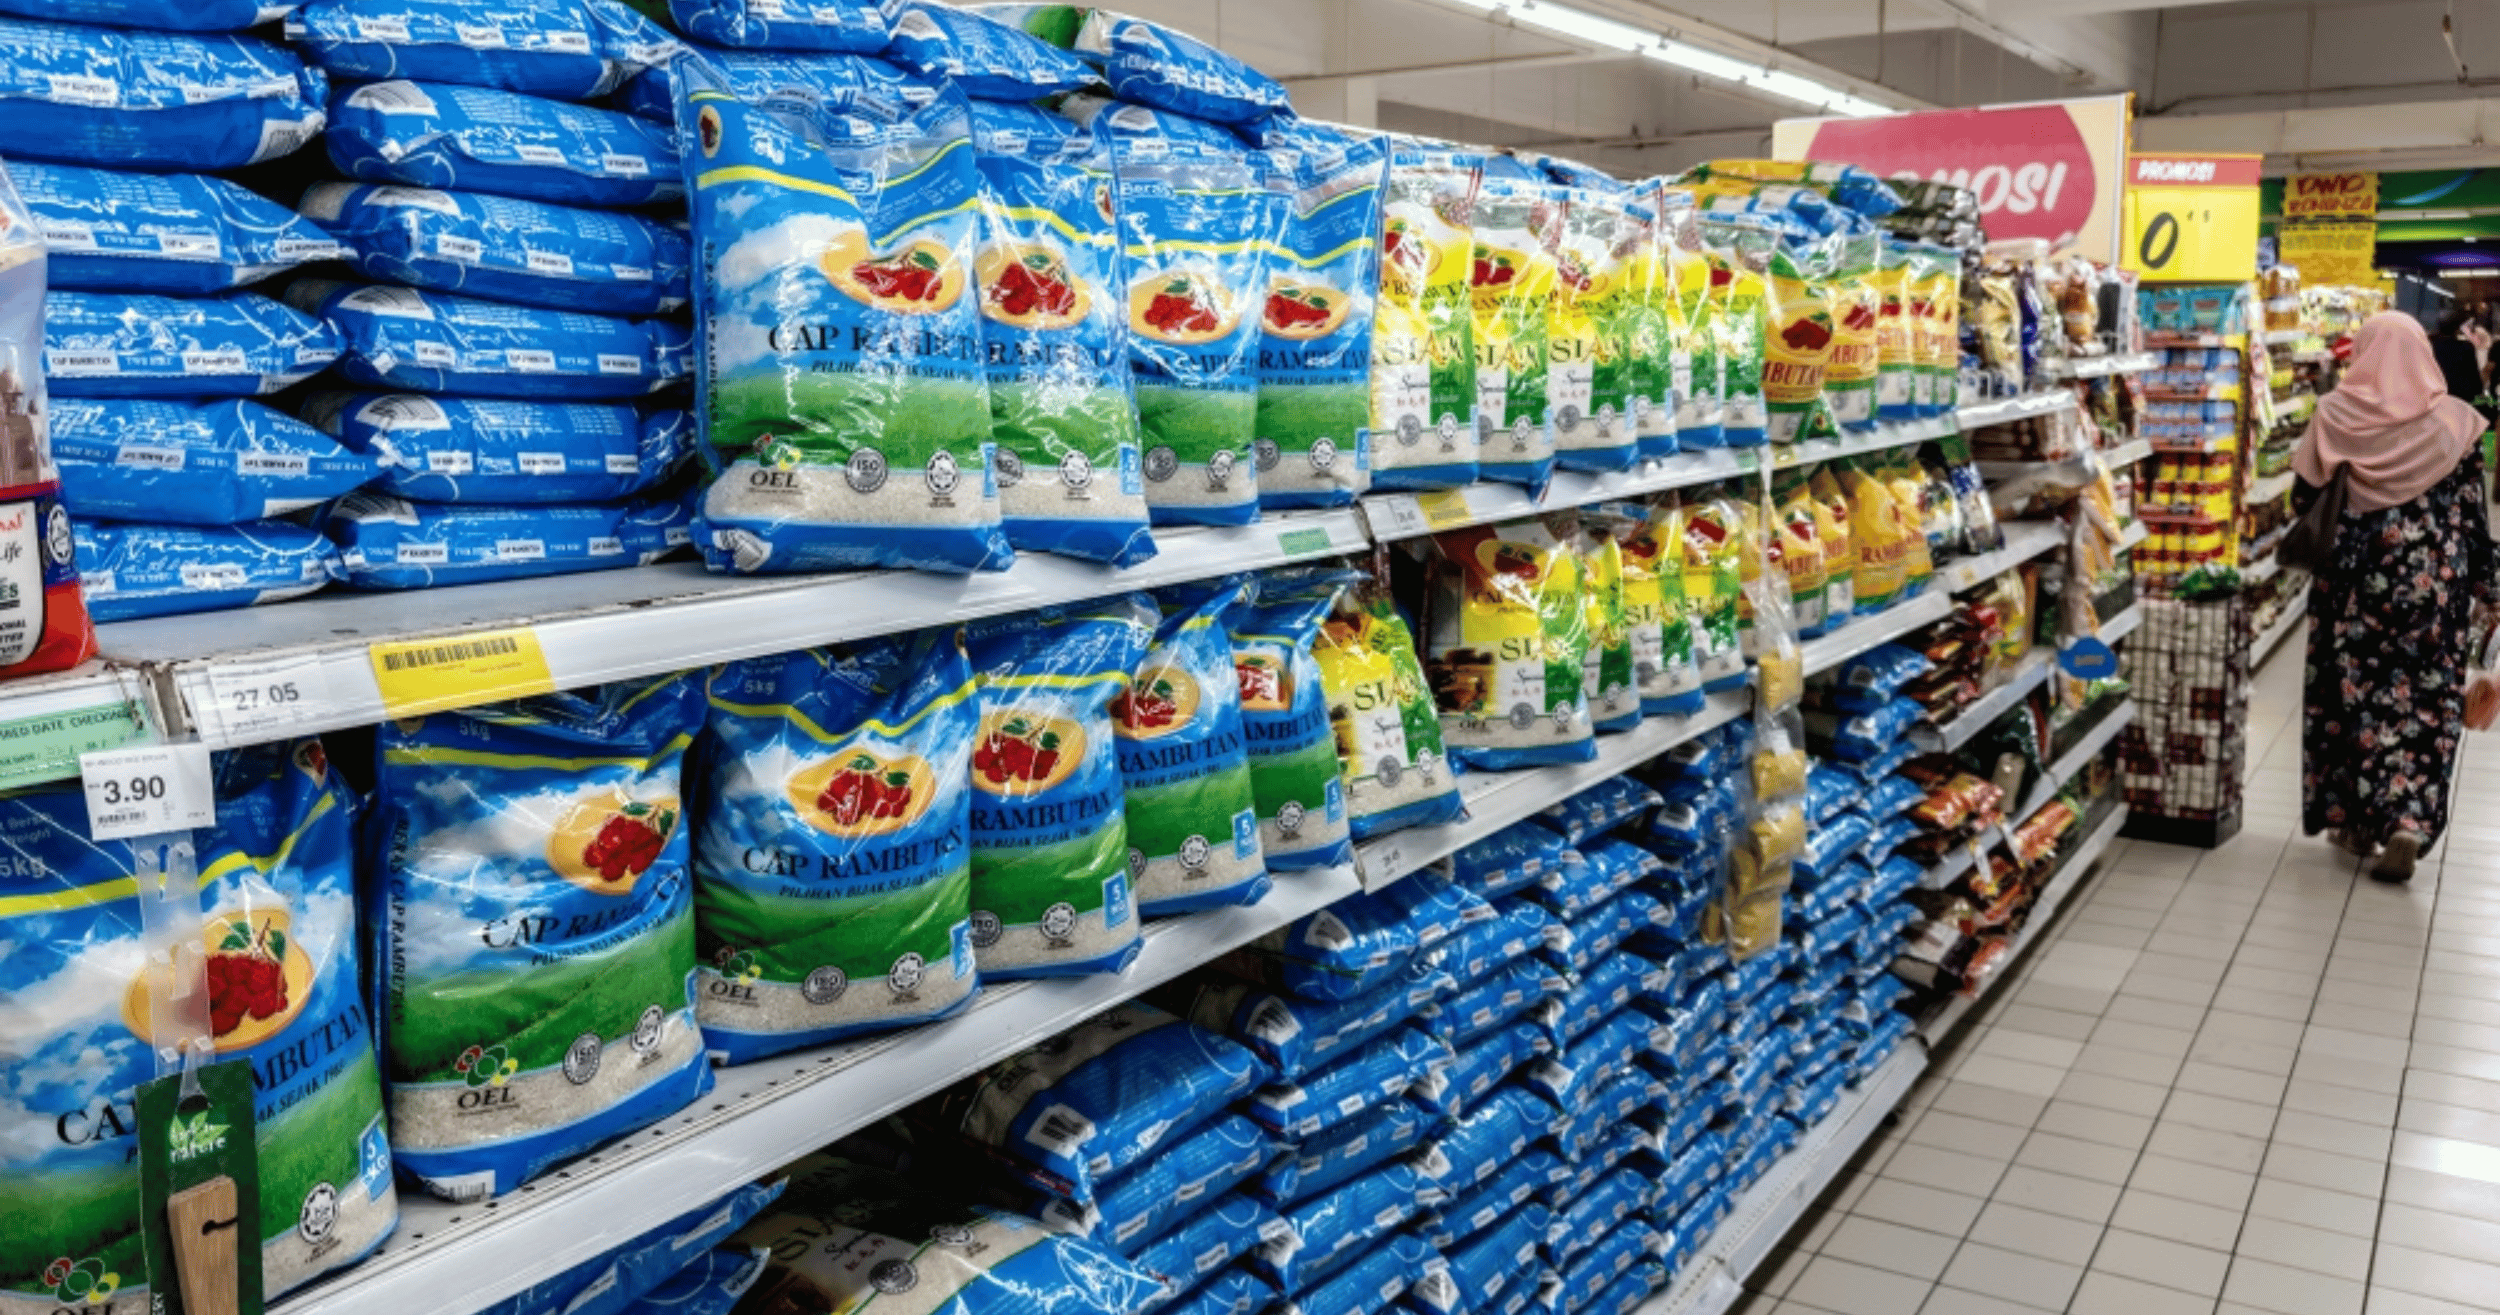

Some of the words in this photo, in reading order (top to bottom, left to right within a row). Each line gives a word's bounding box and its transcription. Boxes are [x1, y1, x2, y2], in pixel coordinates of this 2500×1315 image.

[768, 323, 840, 352] CAP
[750, 471, 799, 490] OEL
[232, 682, 300, 711] 27.05
[1119, 731, 1241, 774] RAMBUTAN
[103, 775, 167, 805] 3.90
[970, 790, 1112, 831] RAMBUTAN
[742, 845, 809, 879] CAP
[819, 824, 964, 880] RAMBUTAN
[481, 916, 561, 950] CAP
[709, 979, 760, 1001] OEL
[456, 1086, 517, 1110] OEL
